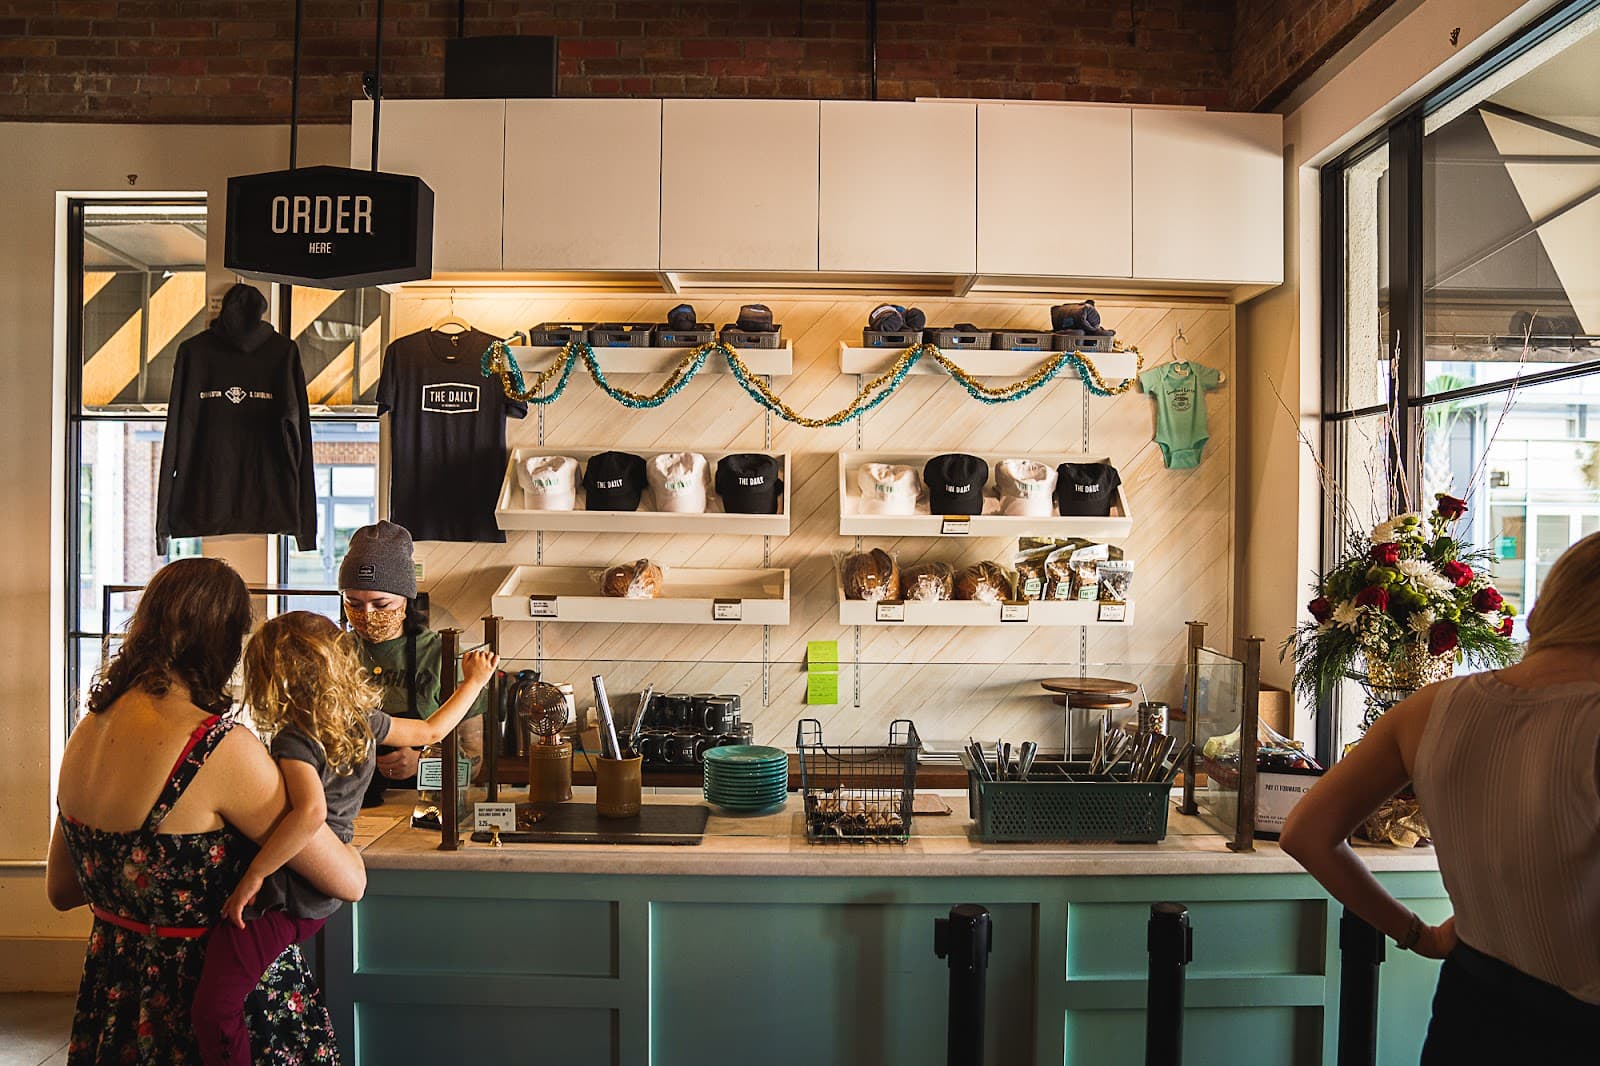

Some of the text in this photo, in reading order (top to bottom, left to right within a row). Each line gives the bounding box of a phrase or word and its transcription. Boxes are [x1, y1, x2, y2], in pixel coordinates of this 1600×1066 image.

[271, 195, 373, 234] ORDER
[309, 242, 332, 254] HERE
[430, 391, 474, 403] THE DAILY
[597, 479, 623, 489] THE DAILY
[738, 477, 749, 486] THE
[1075, 484, 1084, 492] THE
[1279, 785, 1301, 793] FORWARD
